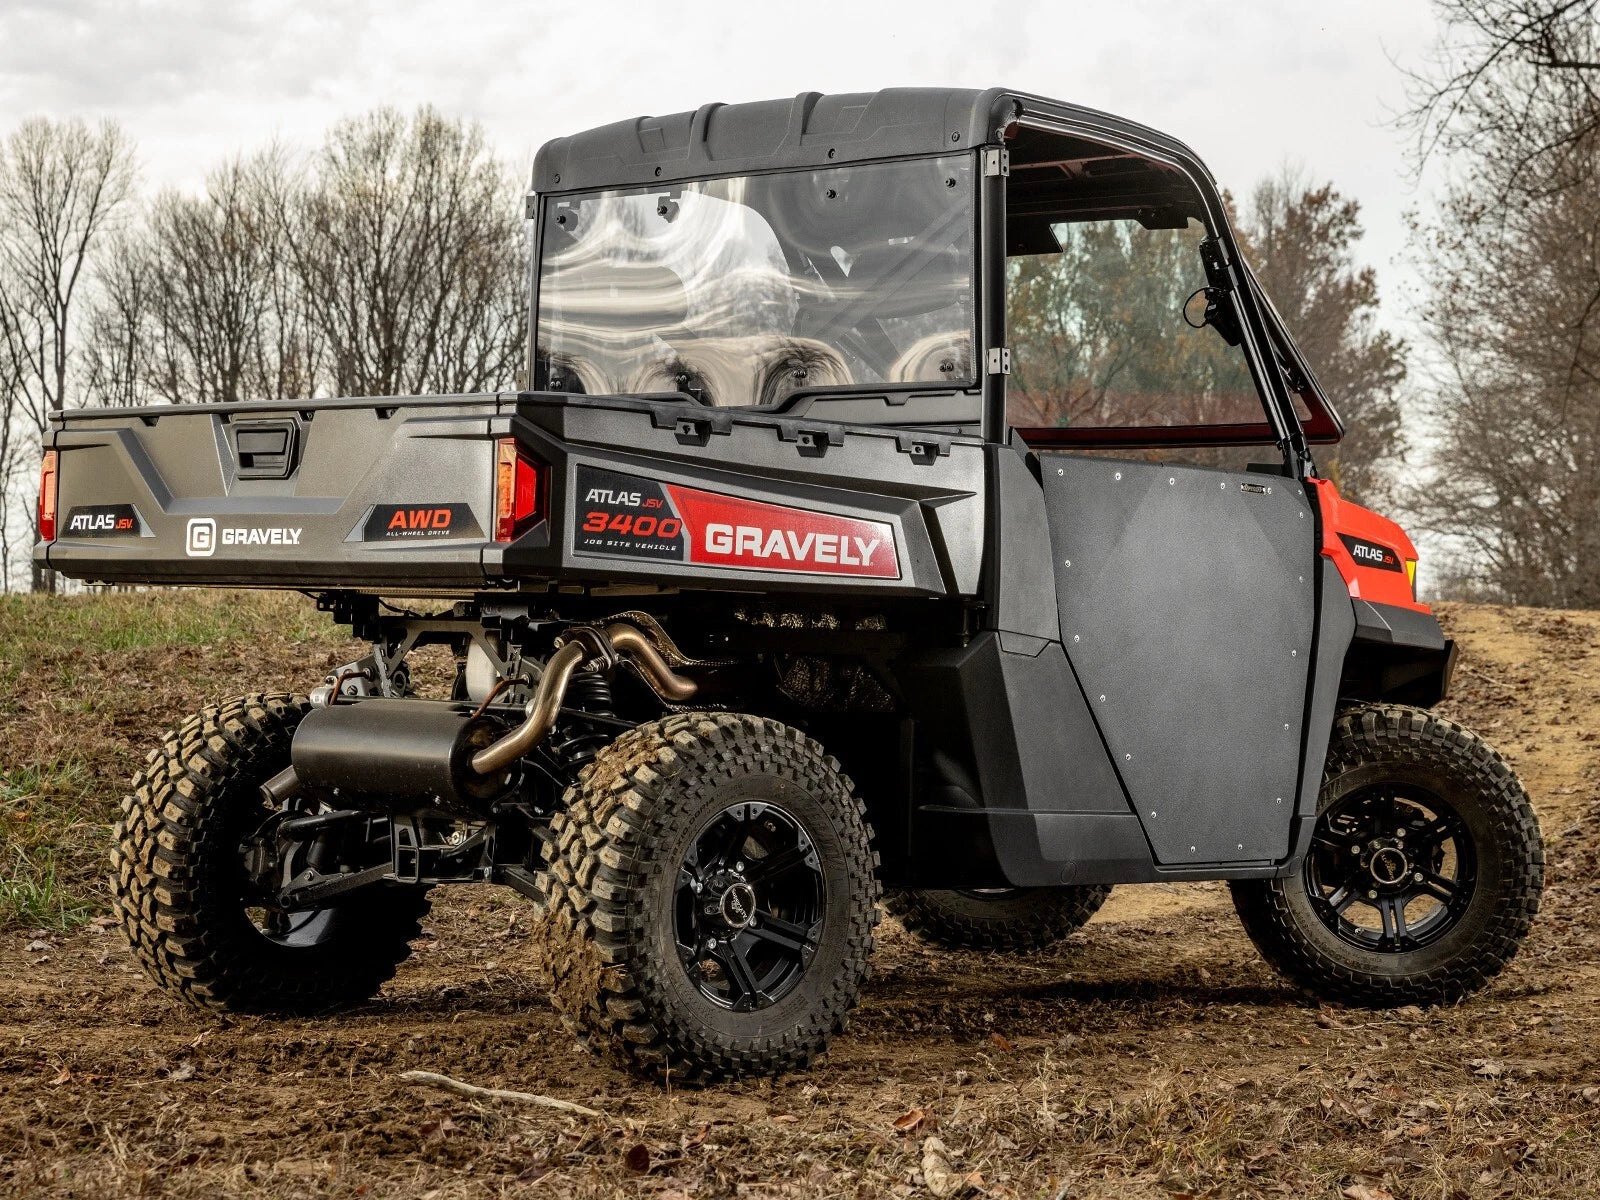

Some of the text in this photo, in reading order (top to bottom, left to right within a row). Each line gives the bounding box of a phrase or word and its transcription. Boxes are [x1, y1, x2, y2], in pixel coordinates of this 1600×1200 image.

[585, 488, 664, 509] ATLAS JSV
[70, 514, 133, 530] ATLAS JSV
[387, 509, 452, 529] AWD
[582, 511, 682, 538] 3400
[221, 528, 303, 545] GRAVELY
[606, 540, 631, 548] SITE
[635, 543, 677, 551] VEHICLE
[705, 522, 880, 567] GRAVELY
[1353, 544, 1383, 562] ATLAS
